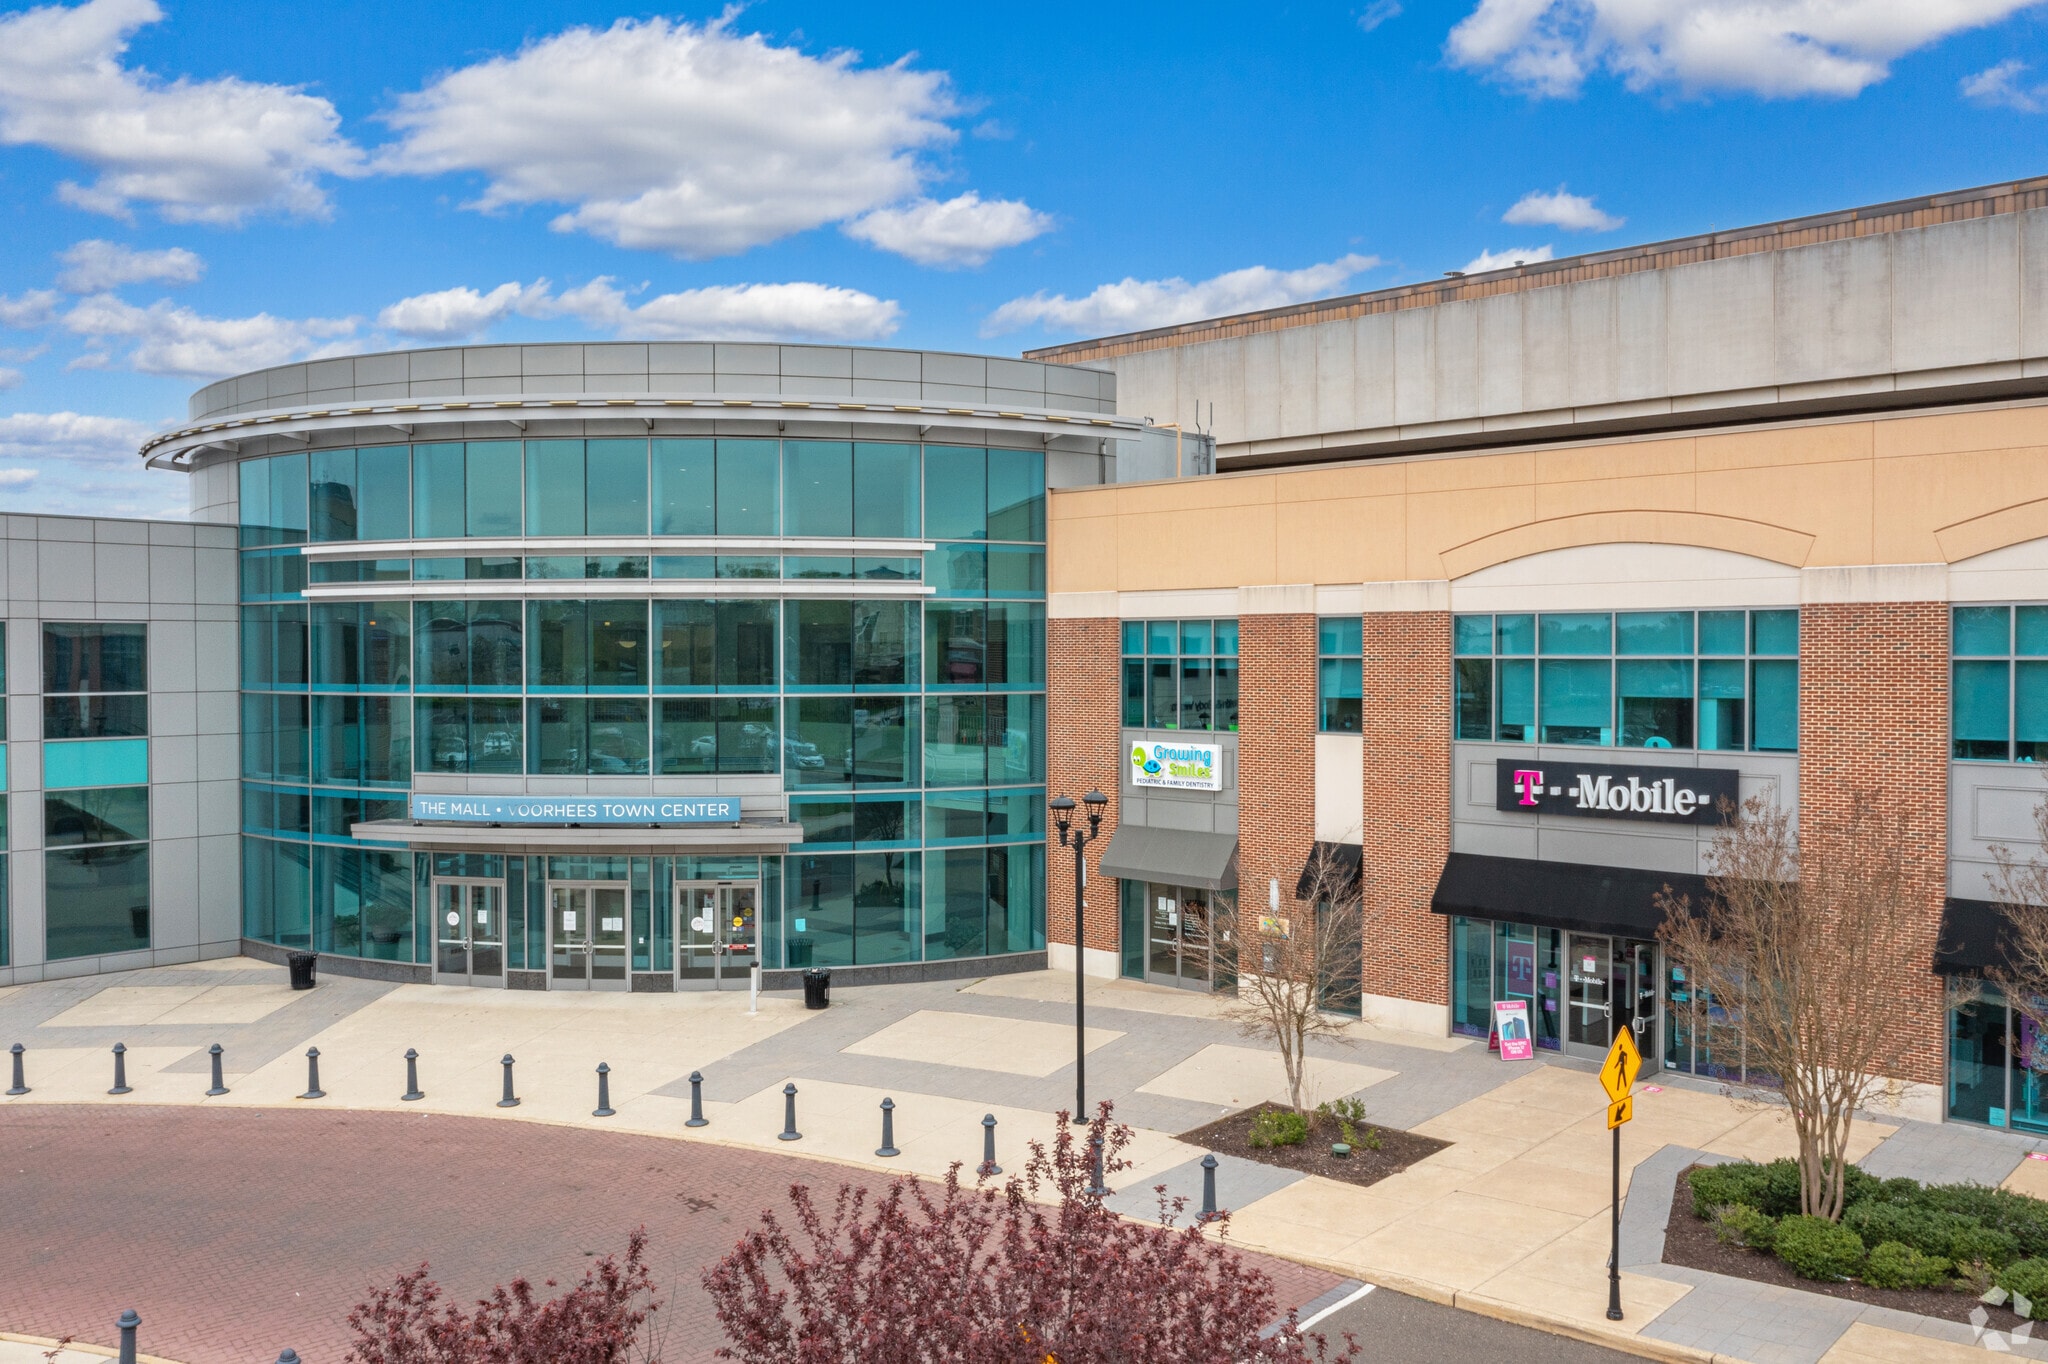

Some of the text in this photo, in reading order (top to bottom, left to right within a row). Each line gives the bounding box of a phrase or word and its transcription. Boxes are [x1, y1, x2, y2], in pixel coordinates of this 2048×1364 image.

[1153, 745, 1212, 767] Growing
[1168, 762, 1211, 778] Smiles
[1136, 777, 1161, 785] PEDIATRIC
[420, 801, 729, 817] THE MALL VOORHEES TOWN CENTER
